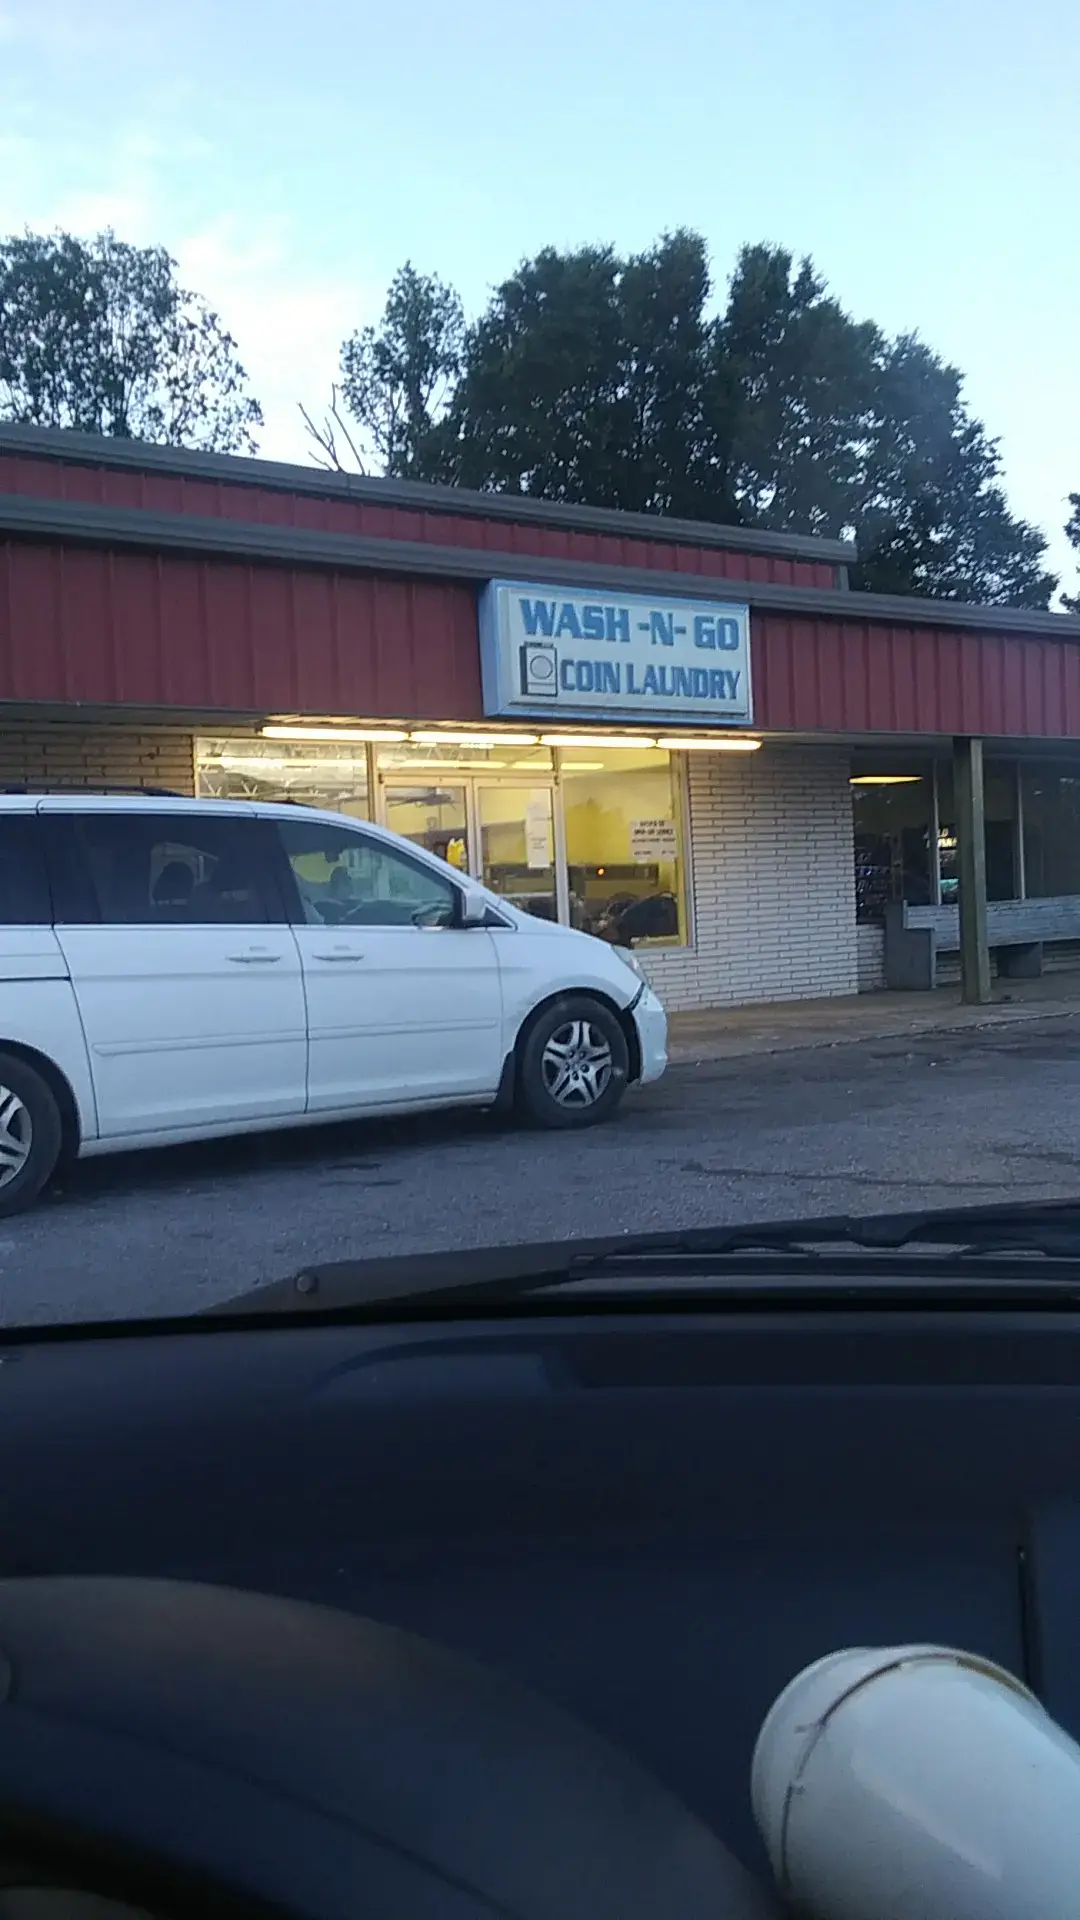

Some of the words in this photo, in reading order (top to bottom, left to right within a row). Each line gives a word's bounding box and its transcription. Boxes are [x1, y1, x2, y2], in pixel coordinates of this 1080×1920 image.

[518, 599, 631, 642] WASH
[693, 615, 739, 651] GO
[560, 659, 620, 694] COIN
[626, 663, 741, 700] LAUNDRY
